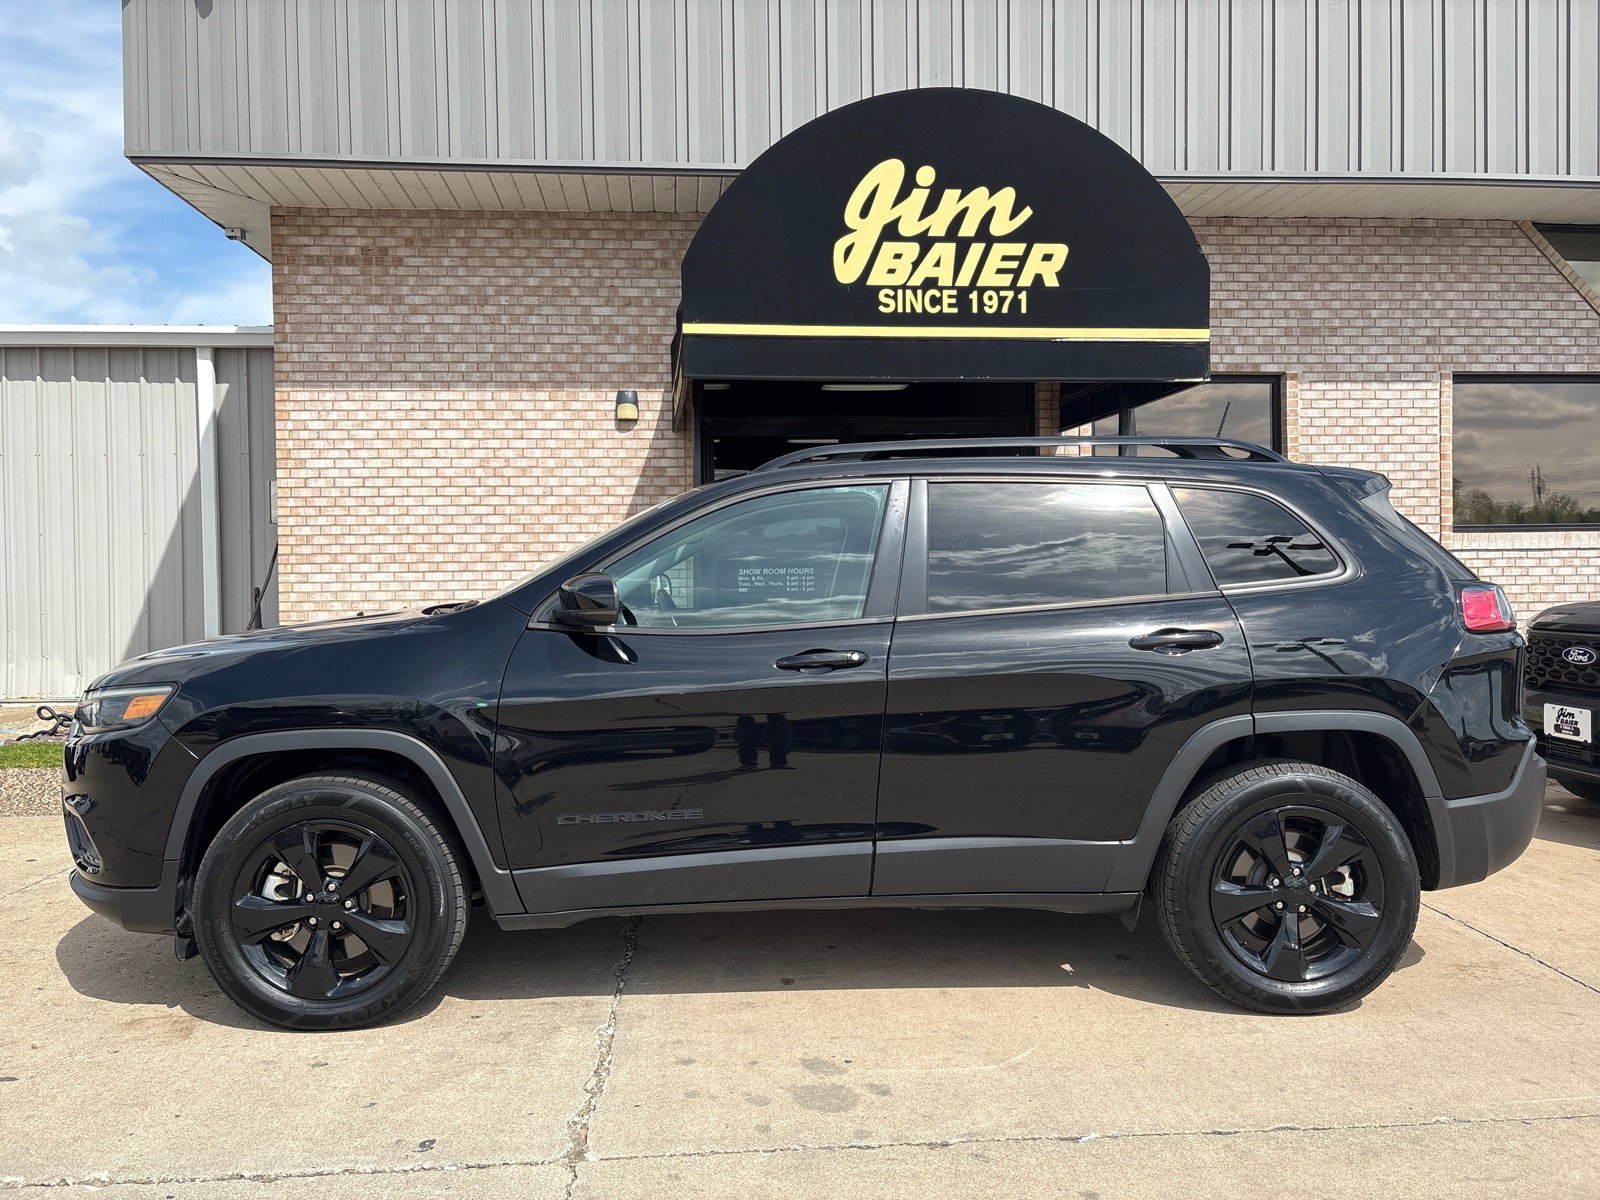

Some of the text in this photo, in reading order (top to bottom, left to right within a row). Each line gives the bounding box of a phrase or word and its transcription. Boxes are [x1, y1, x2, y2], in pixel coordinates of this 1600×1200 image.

[833, 158, 1033, 284] Jim
[866, 242, 1069, 287] BAIER
[878, 288, 1028, 314] SINCE 1971
[738, 568, 761, 576] SHOW
[787, 567, 815, 575] HOURS
[1555, 707, 1576, 723] Jim
[1560, 718, 1579, 726] BAIER
[556, 808, 703, 825] CHEROKEE
